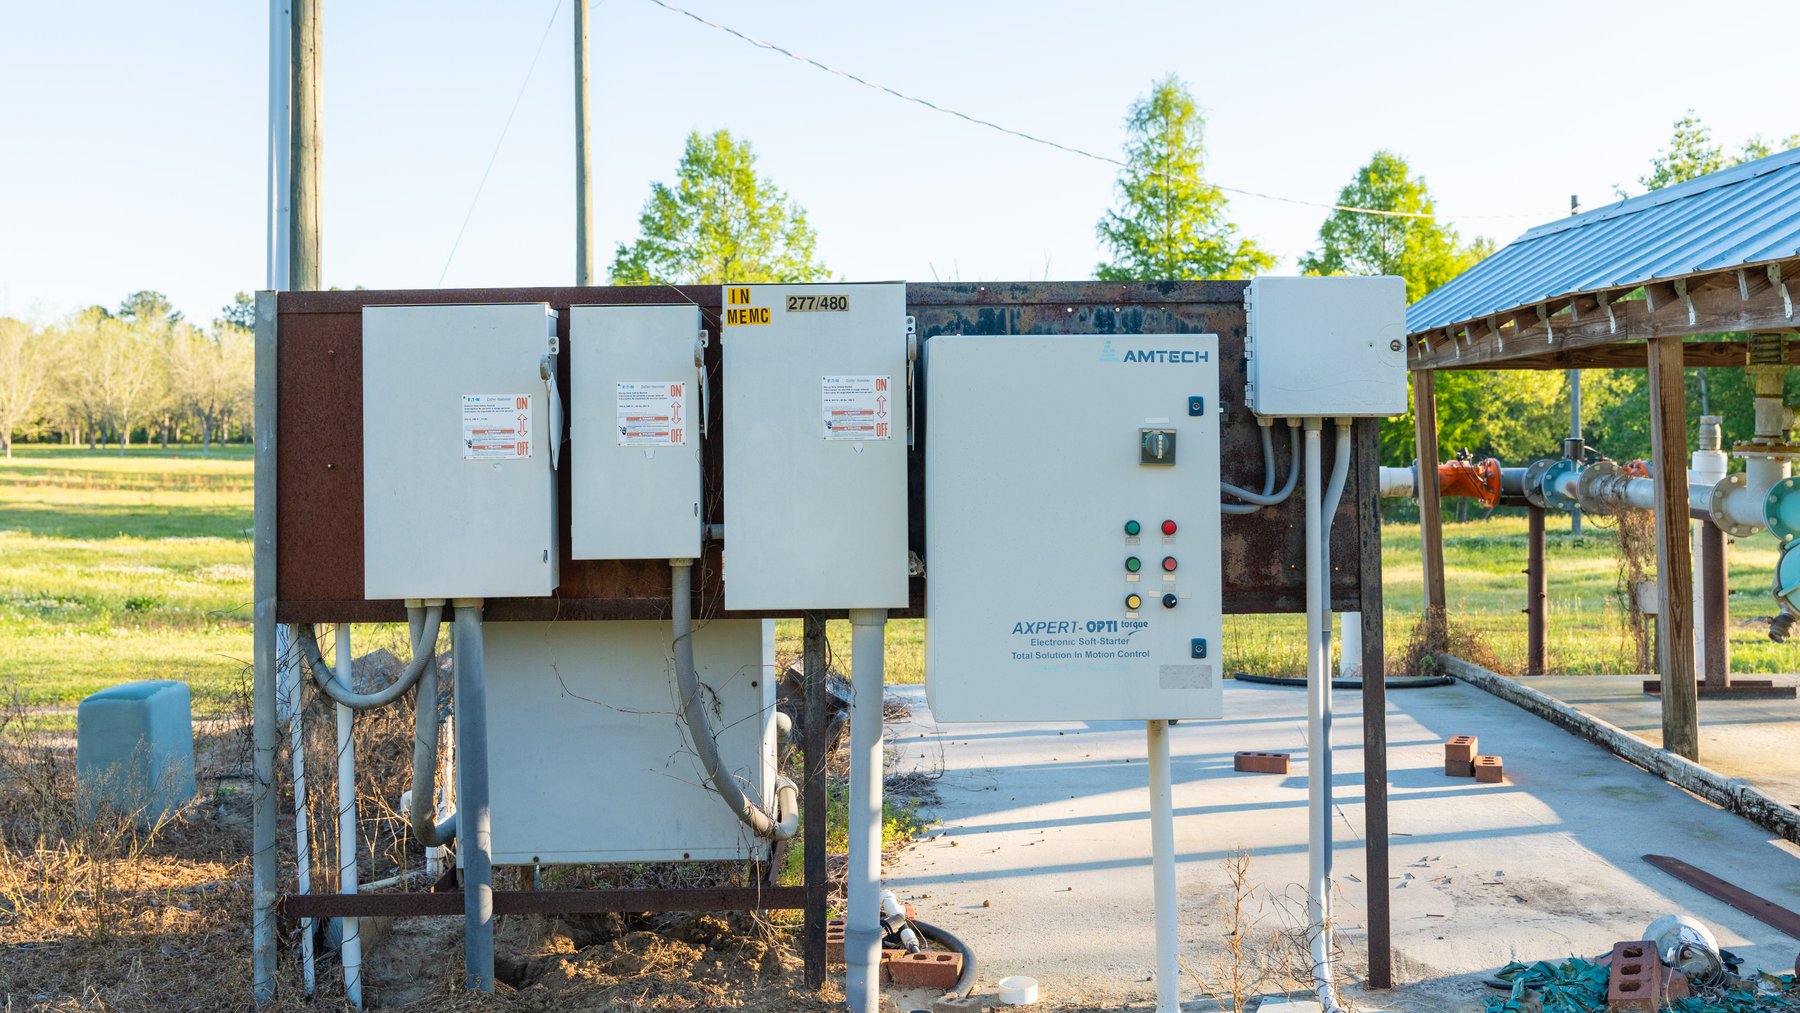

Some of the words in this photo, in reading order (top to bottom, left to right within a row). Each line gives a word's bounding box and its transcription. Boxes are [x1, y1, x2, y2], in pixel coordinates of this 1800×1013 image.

[732, 289, 750, 304] IN
[788, 296, 847, 310] 277/480
[727, 308, 769, 324] MEMC
[1123, 350, 1209, 363] AMTECH
[670, 384, 682, 397] ON
[876, 378, 887, 391] ON
[516, 397, 528, 410] ON
[670, 428, 683, 443] OFF
[876, 422, 888, 437] OFF
[516, 441, 529, 456] OFF
[1121, 620, 1149, 630] torque
[1030, 638, 1076, 647] Electronic
[1078, 637, 1130, 646] Soft-Starter
[1012, 651, 1033, 660] Total
[1035, 651, 1072, 659] Solution
[1074, 651, 1083, 659] In
[1085, 650, 1115, 659] Motion
[1117, 650, 1150, 658] Control
